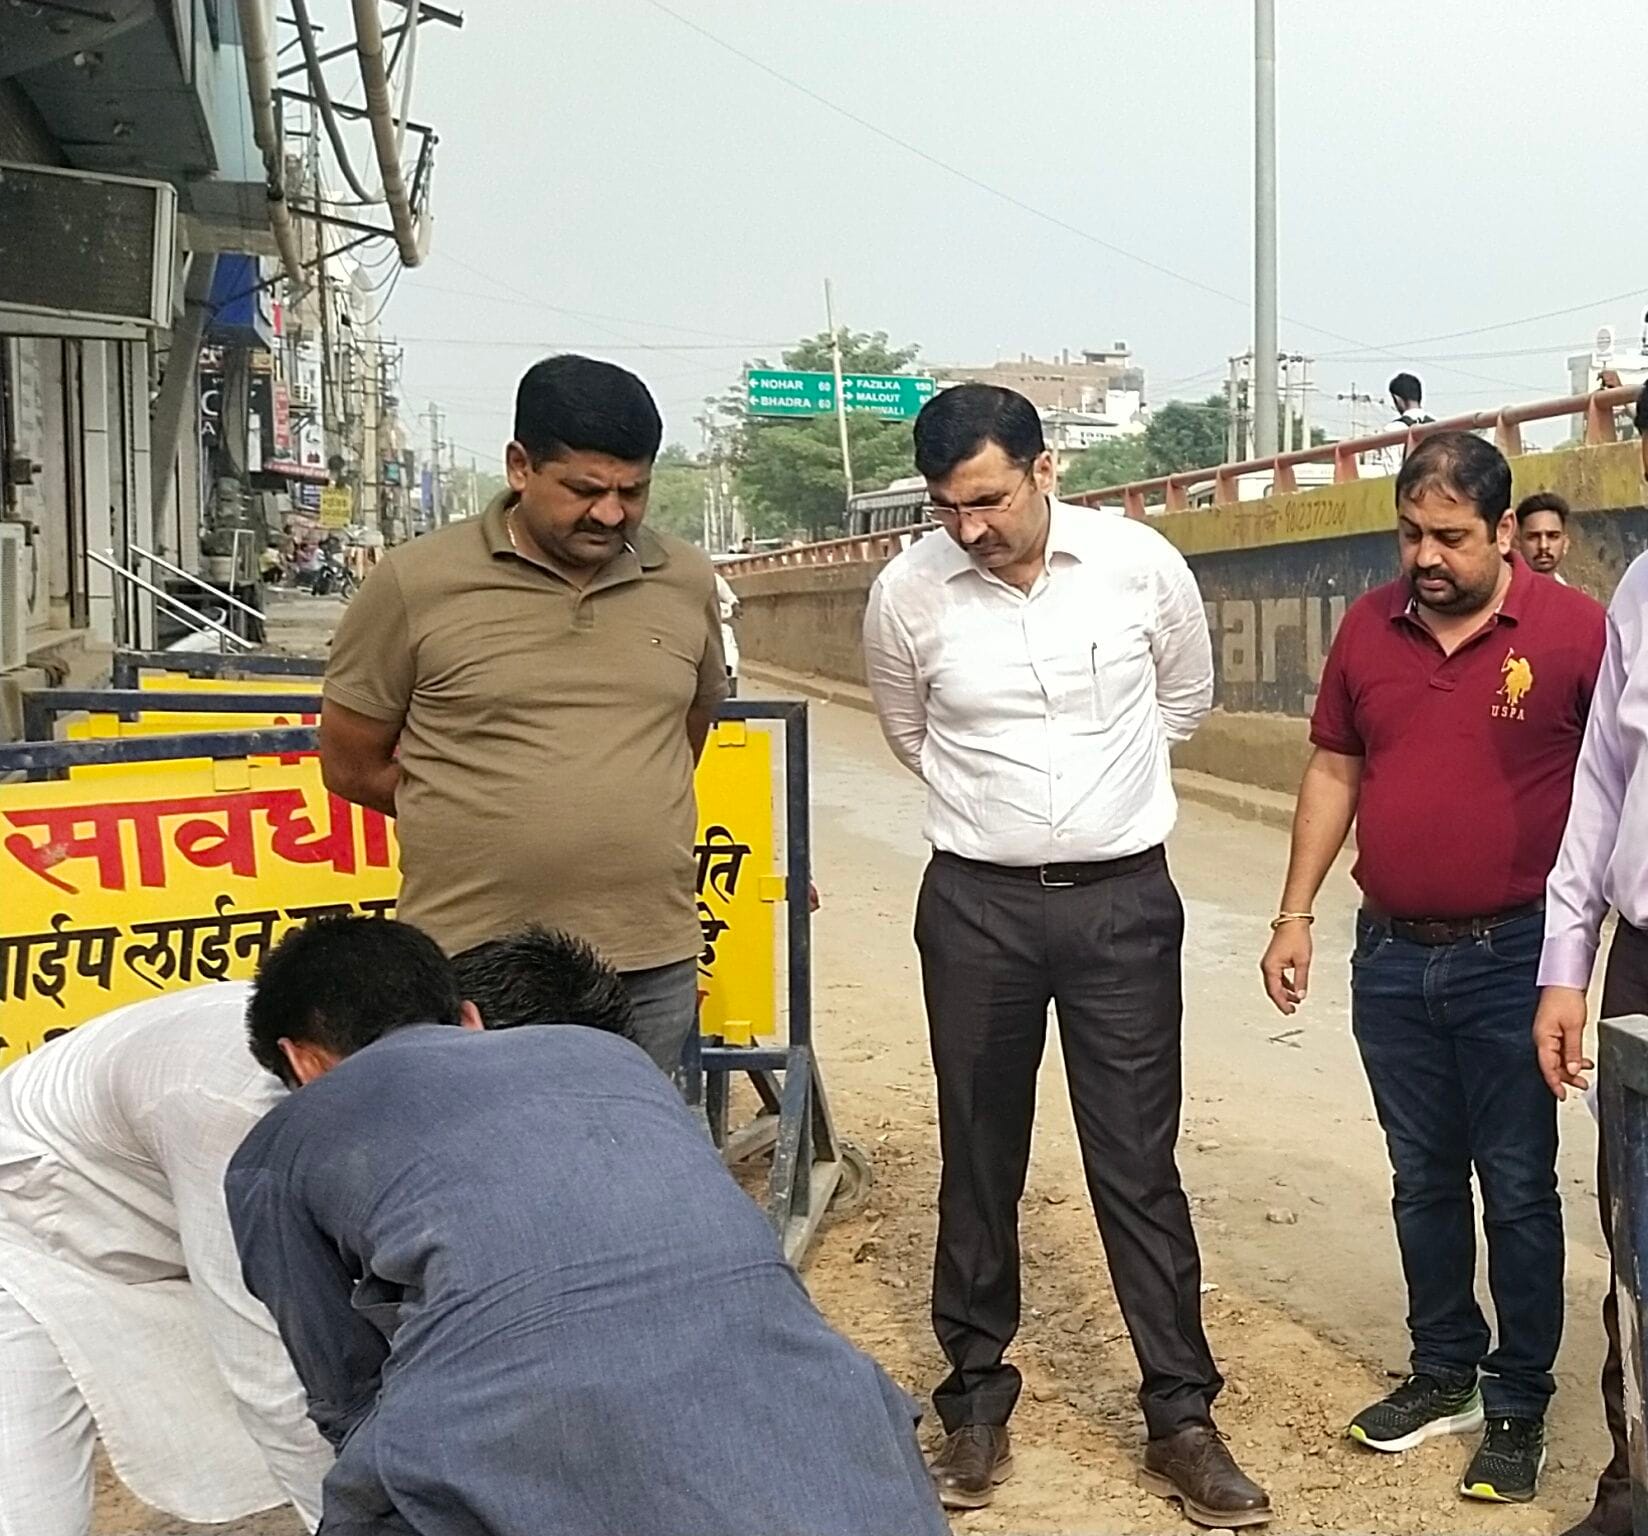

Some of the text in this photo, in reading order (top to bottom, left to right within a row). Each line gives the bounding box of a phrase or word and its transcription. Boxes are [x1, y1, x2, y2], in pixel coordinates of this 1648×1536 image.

[760, 378, 804, 390] NOHAR
[856, 380, 900, 390] FAZILKA
[760, 397, 811, 408] BHADRA
[856, 391, 900, 403] MALOUT
[3, 788, 392, 895] सावधा
